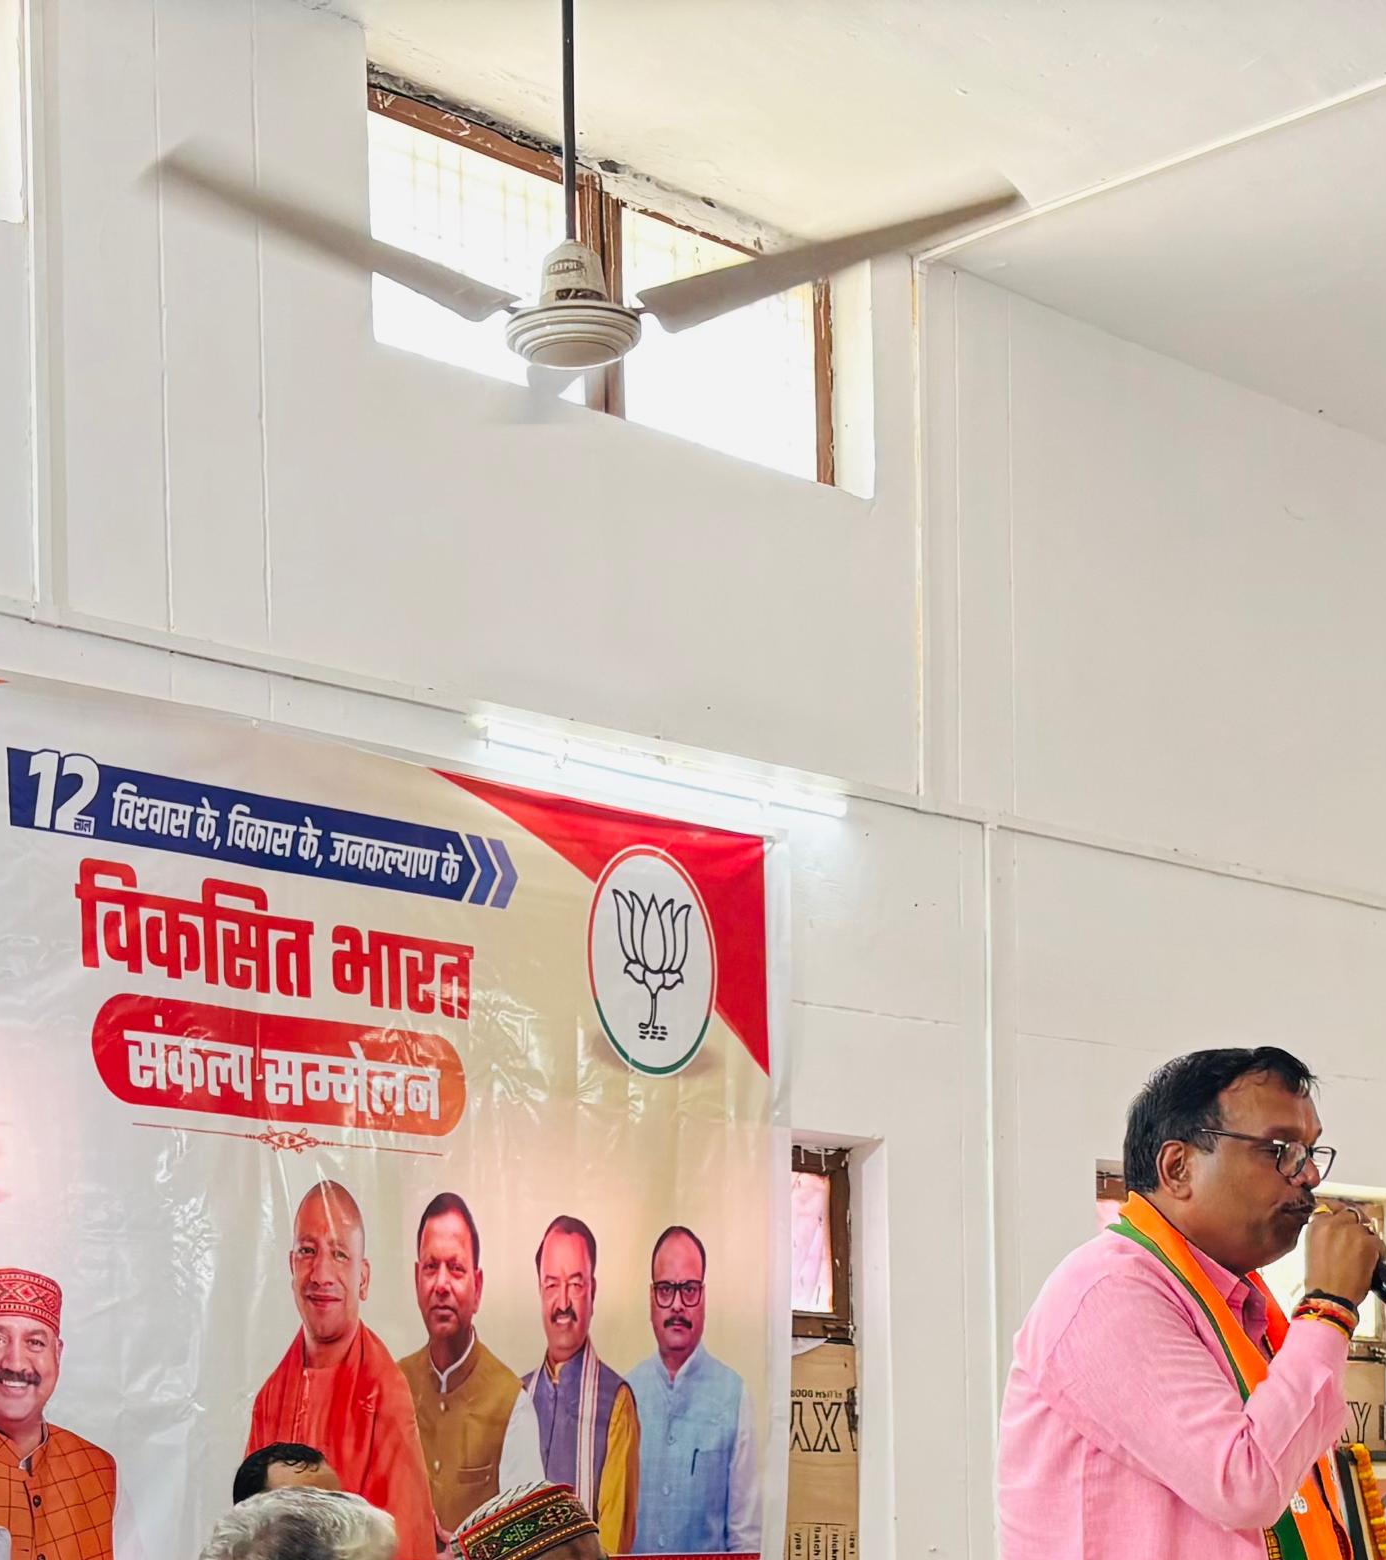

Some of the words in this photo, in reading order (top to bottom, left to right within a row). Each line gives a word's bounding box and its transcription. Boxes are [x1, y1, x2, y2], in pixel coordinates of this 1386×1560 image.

[28, 751, 100, 835] 12
[111, 782, 195, 839] विश्वास
[195, 796, 221, 850] के,
[226, 803, 297, 858] विकास
[297, 816, 323, 869] के,
[329, 831, 440, 882] जनकल्याण
[439, 842, 463, 885] के
[74, 857, 314, 999] विकसित
[331, 925, 475, 1020] भारत
[123, 1014, 254, 1102] संकल्प
[260, 1042, 442, 1121] सम्मेलन
